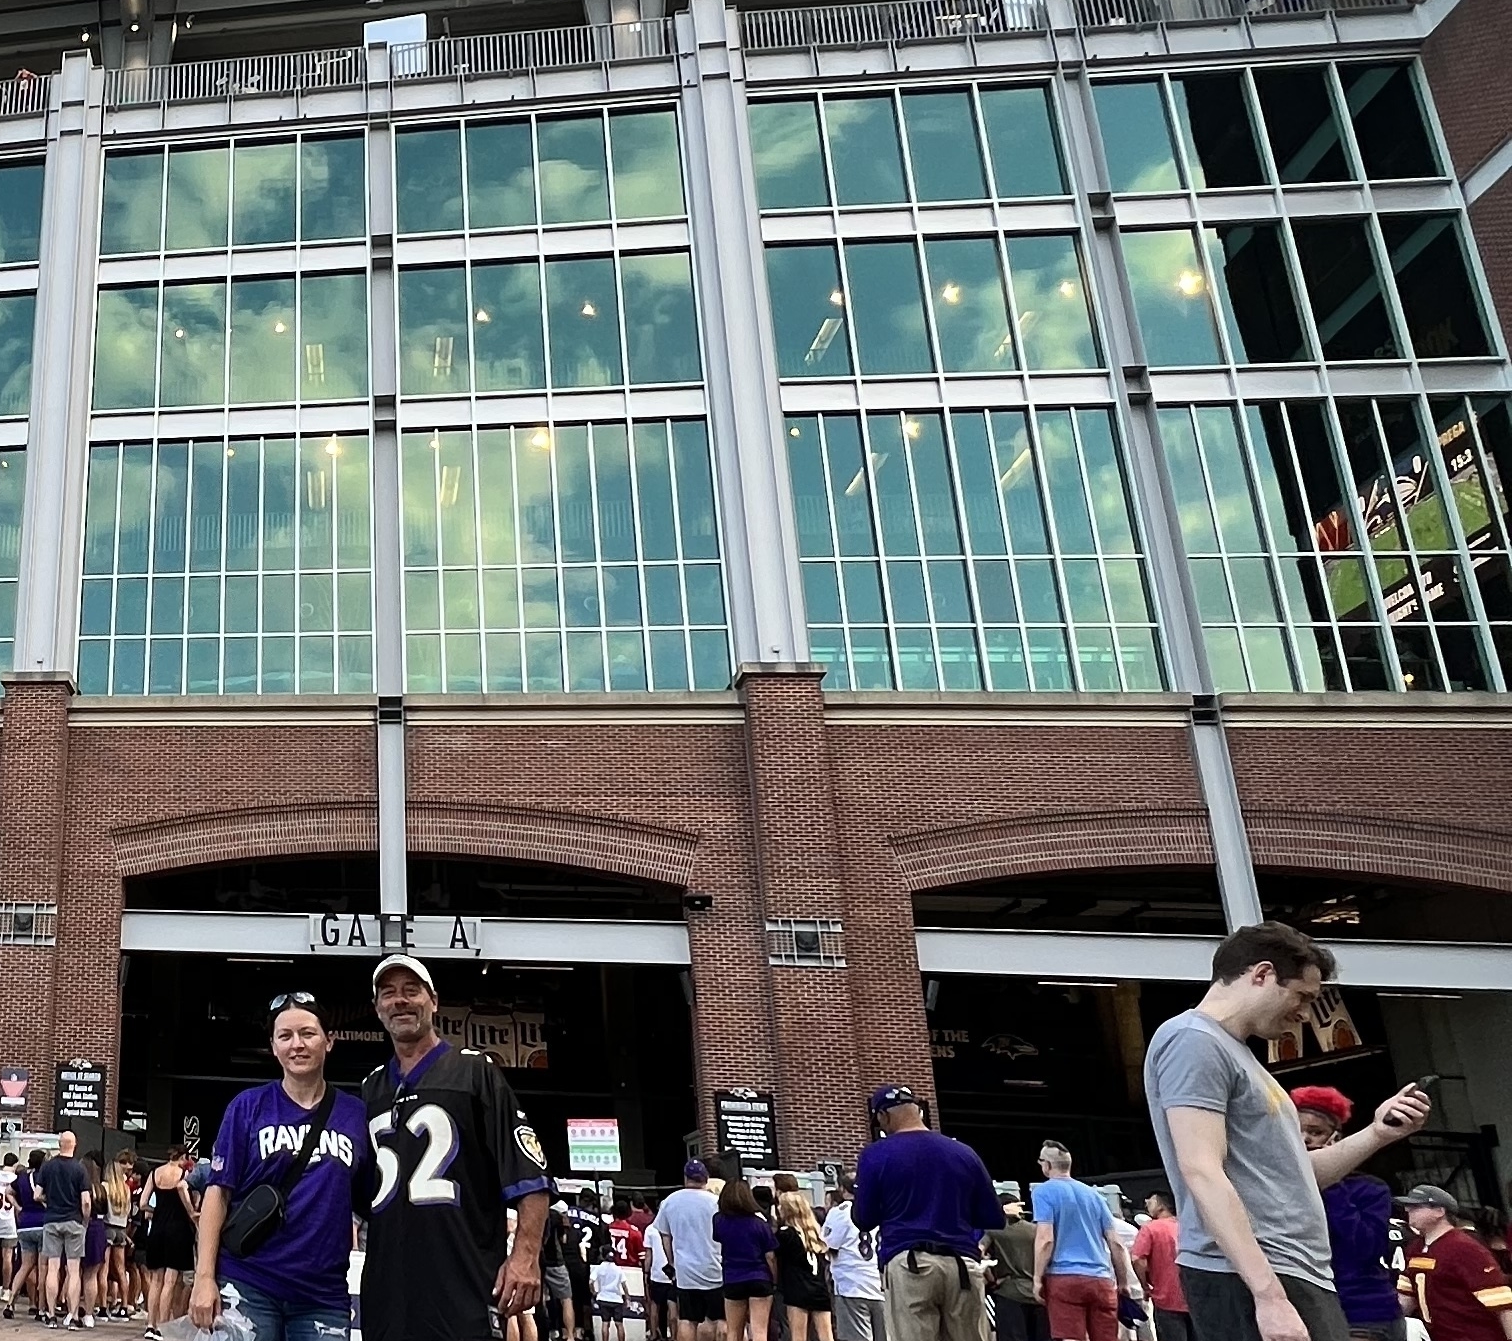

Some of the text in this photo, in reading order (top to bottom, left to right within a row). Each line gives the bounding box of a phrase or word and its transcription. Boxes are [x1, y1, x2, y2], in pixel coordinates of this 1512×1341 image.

[321, 913, 470, 950] GATE A
[368, 1103, 460, 1215] 52
